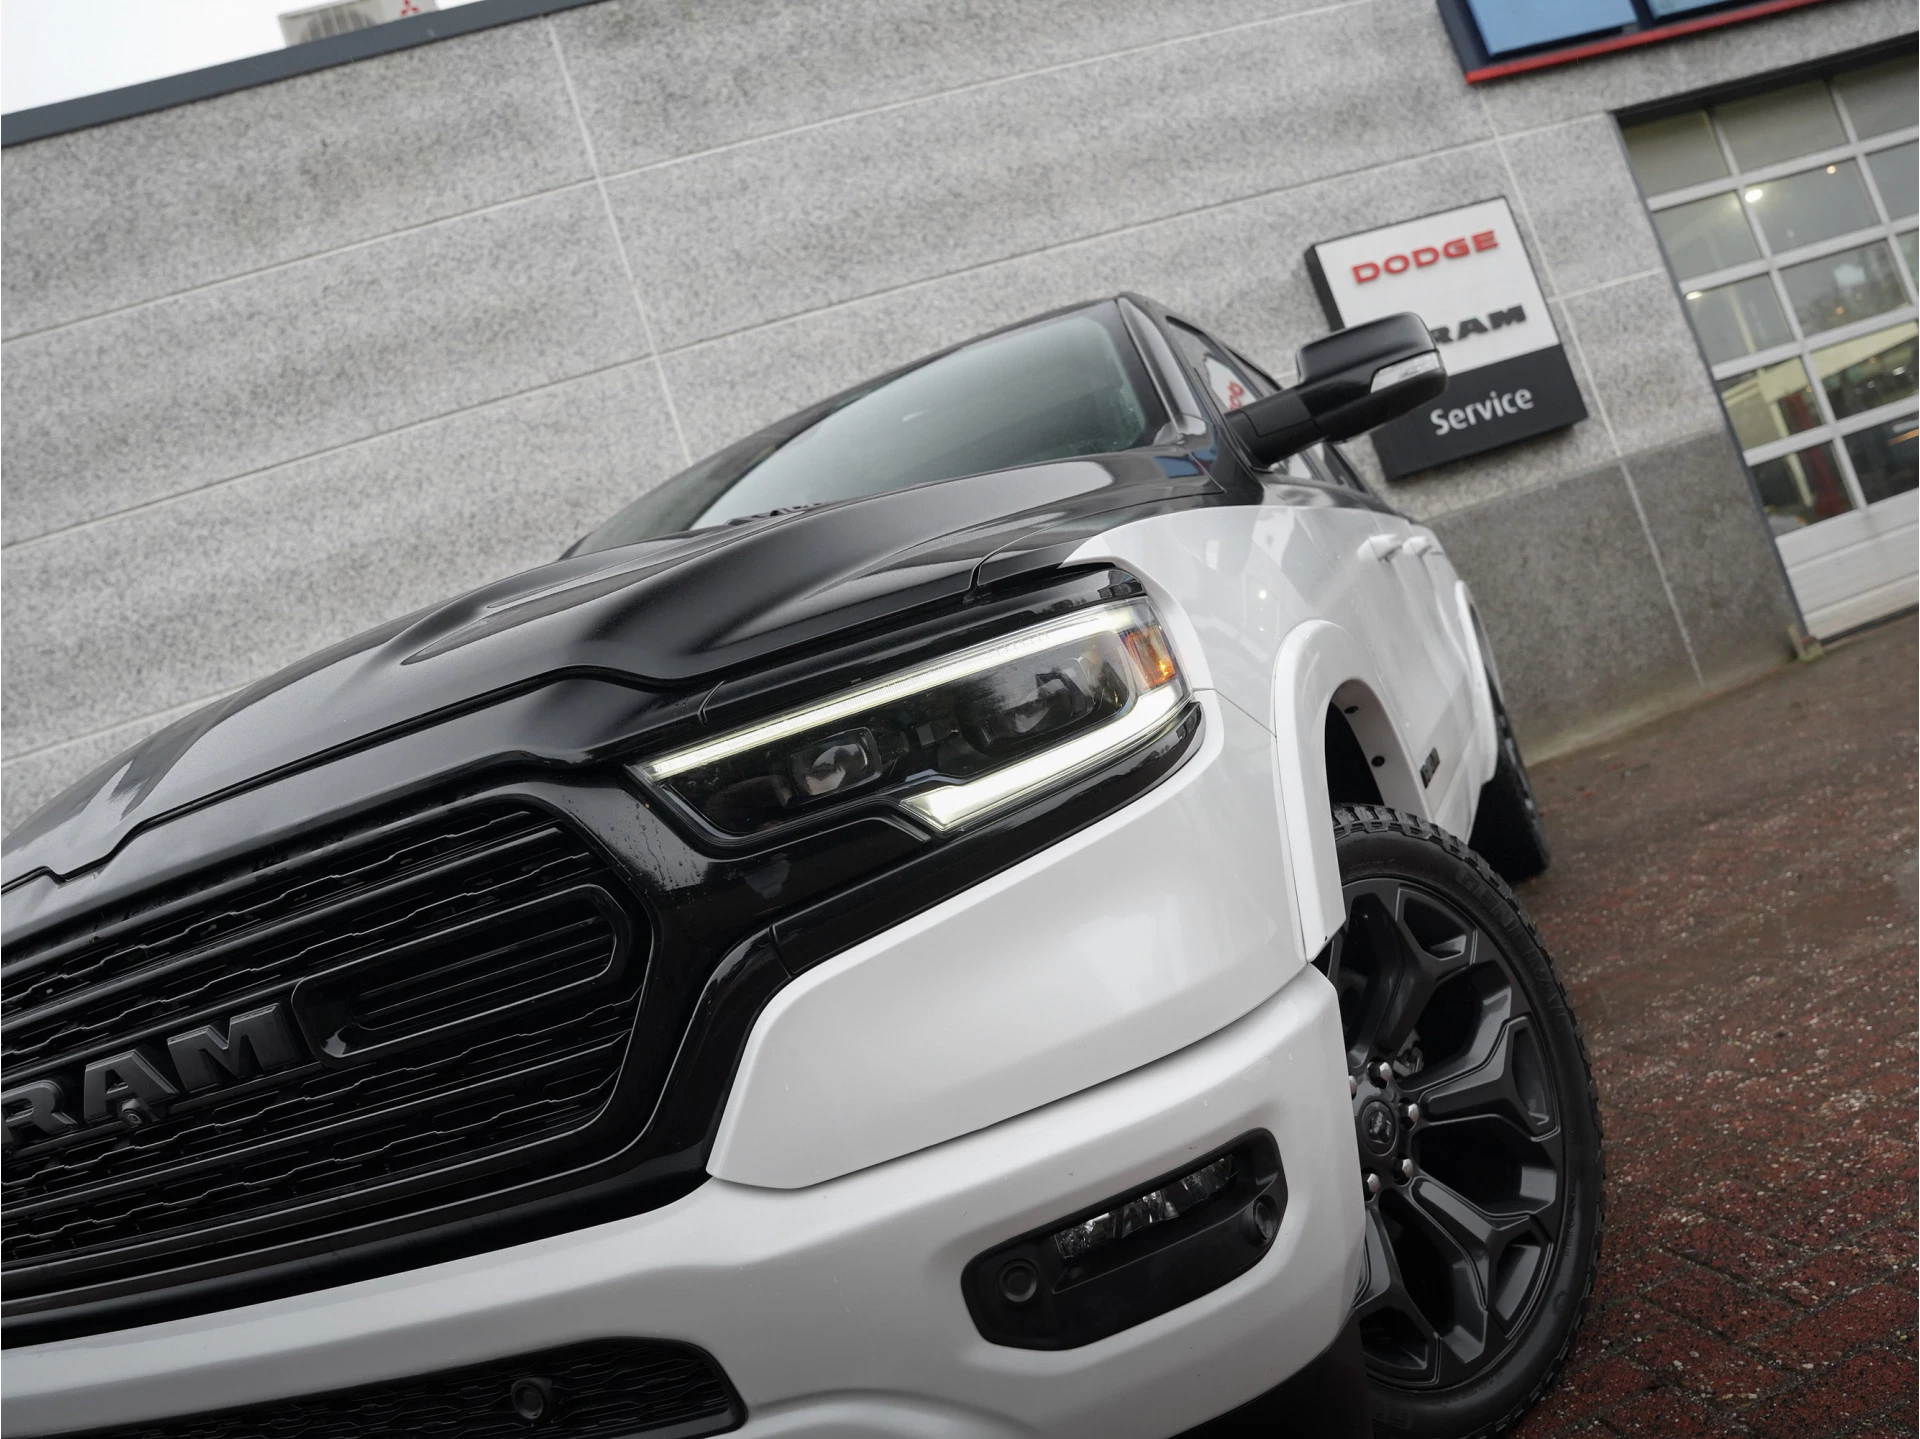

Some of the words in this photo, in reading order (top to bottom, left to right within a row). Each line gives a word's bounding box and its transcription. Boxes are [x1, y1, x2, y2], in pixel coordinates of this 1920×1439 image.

[1352, 230, 1498, 284] DODGE
[1430, 388, 1534, 435] Service
[0, 1003, 297, 1146] RAM
